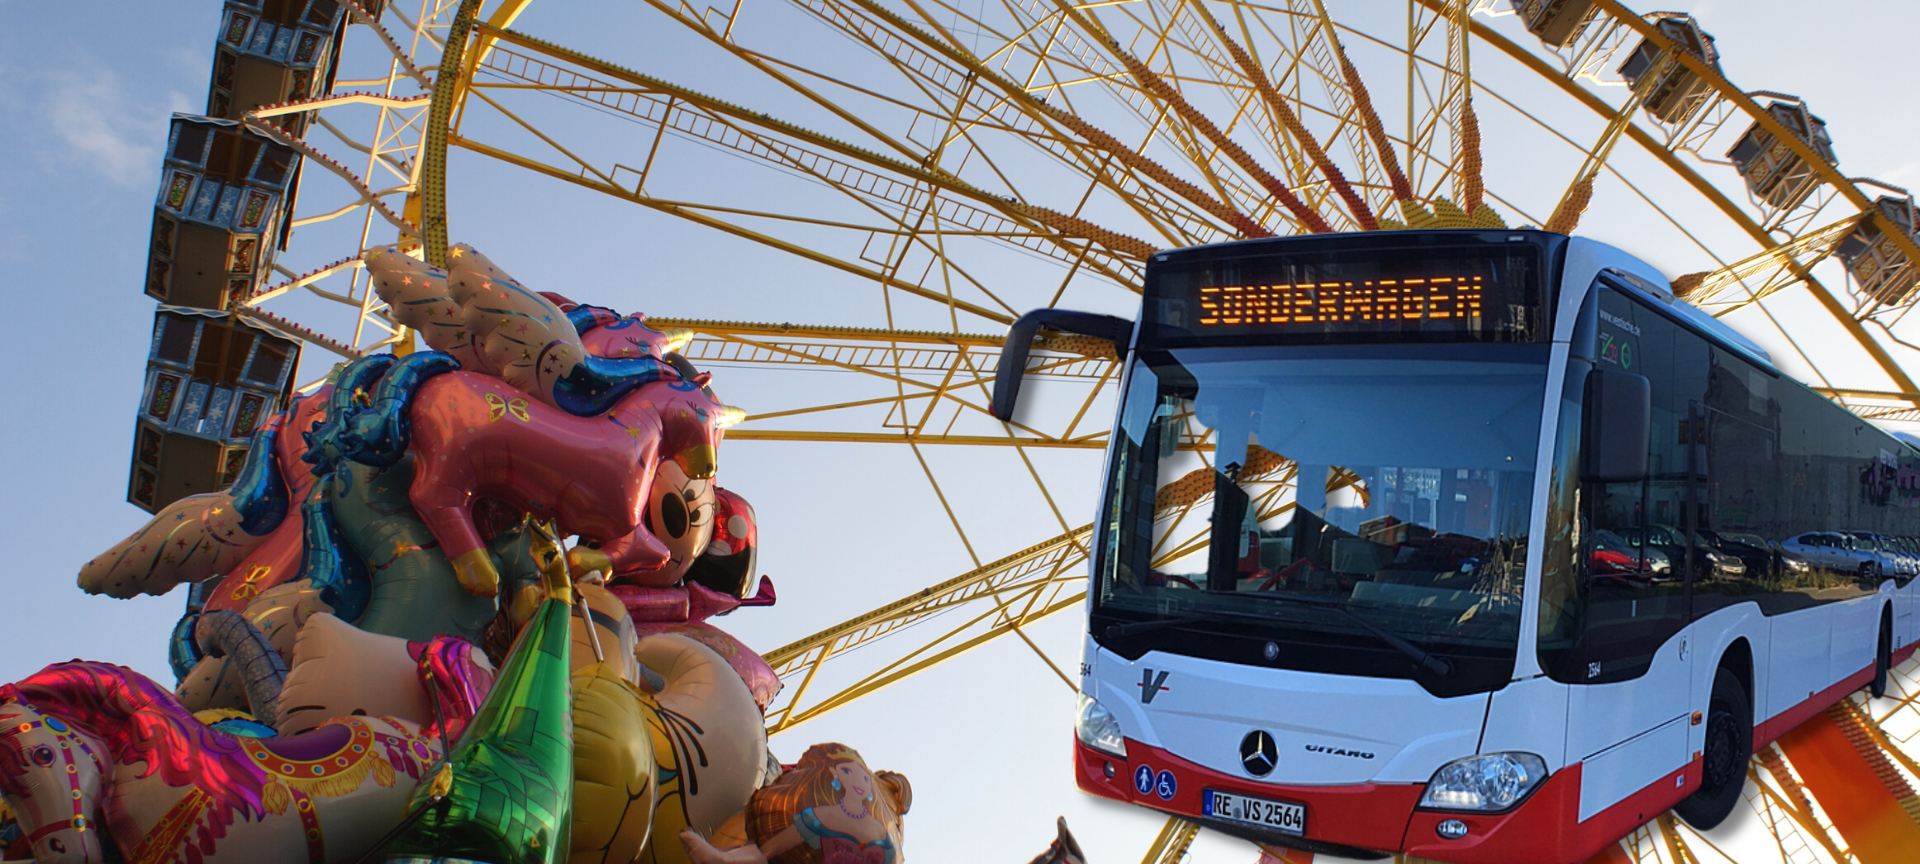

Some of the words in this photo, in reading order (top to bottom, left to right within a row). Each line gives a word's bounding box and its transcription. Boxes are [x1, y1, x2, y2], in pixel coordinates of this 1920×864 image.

[1200, 276, 1482, 323] SONDERWAGEN
[1588, 661, 1601, 678] 2564
[1214, 794, 1232, 816] RE
[1243, 799, 1261, 821] VS
[1265, 803, 1302, 829] 2564
